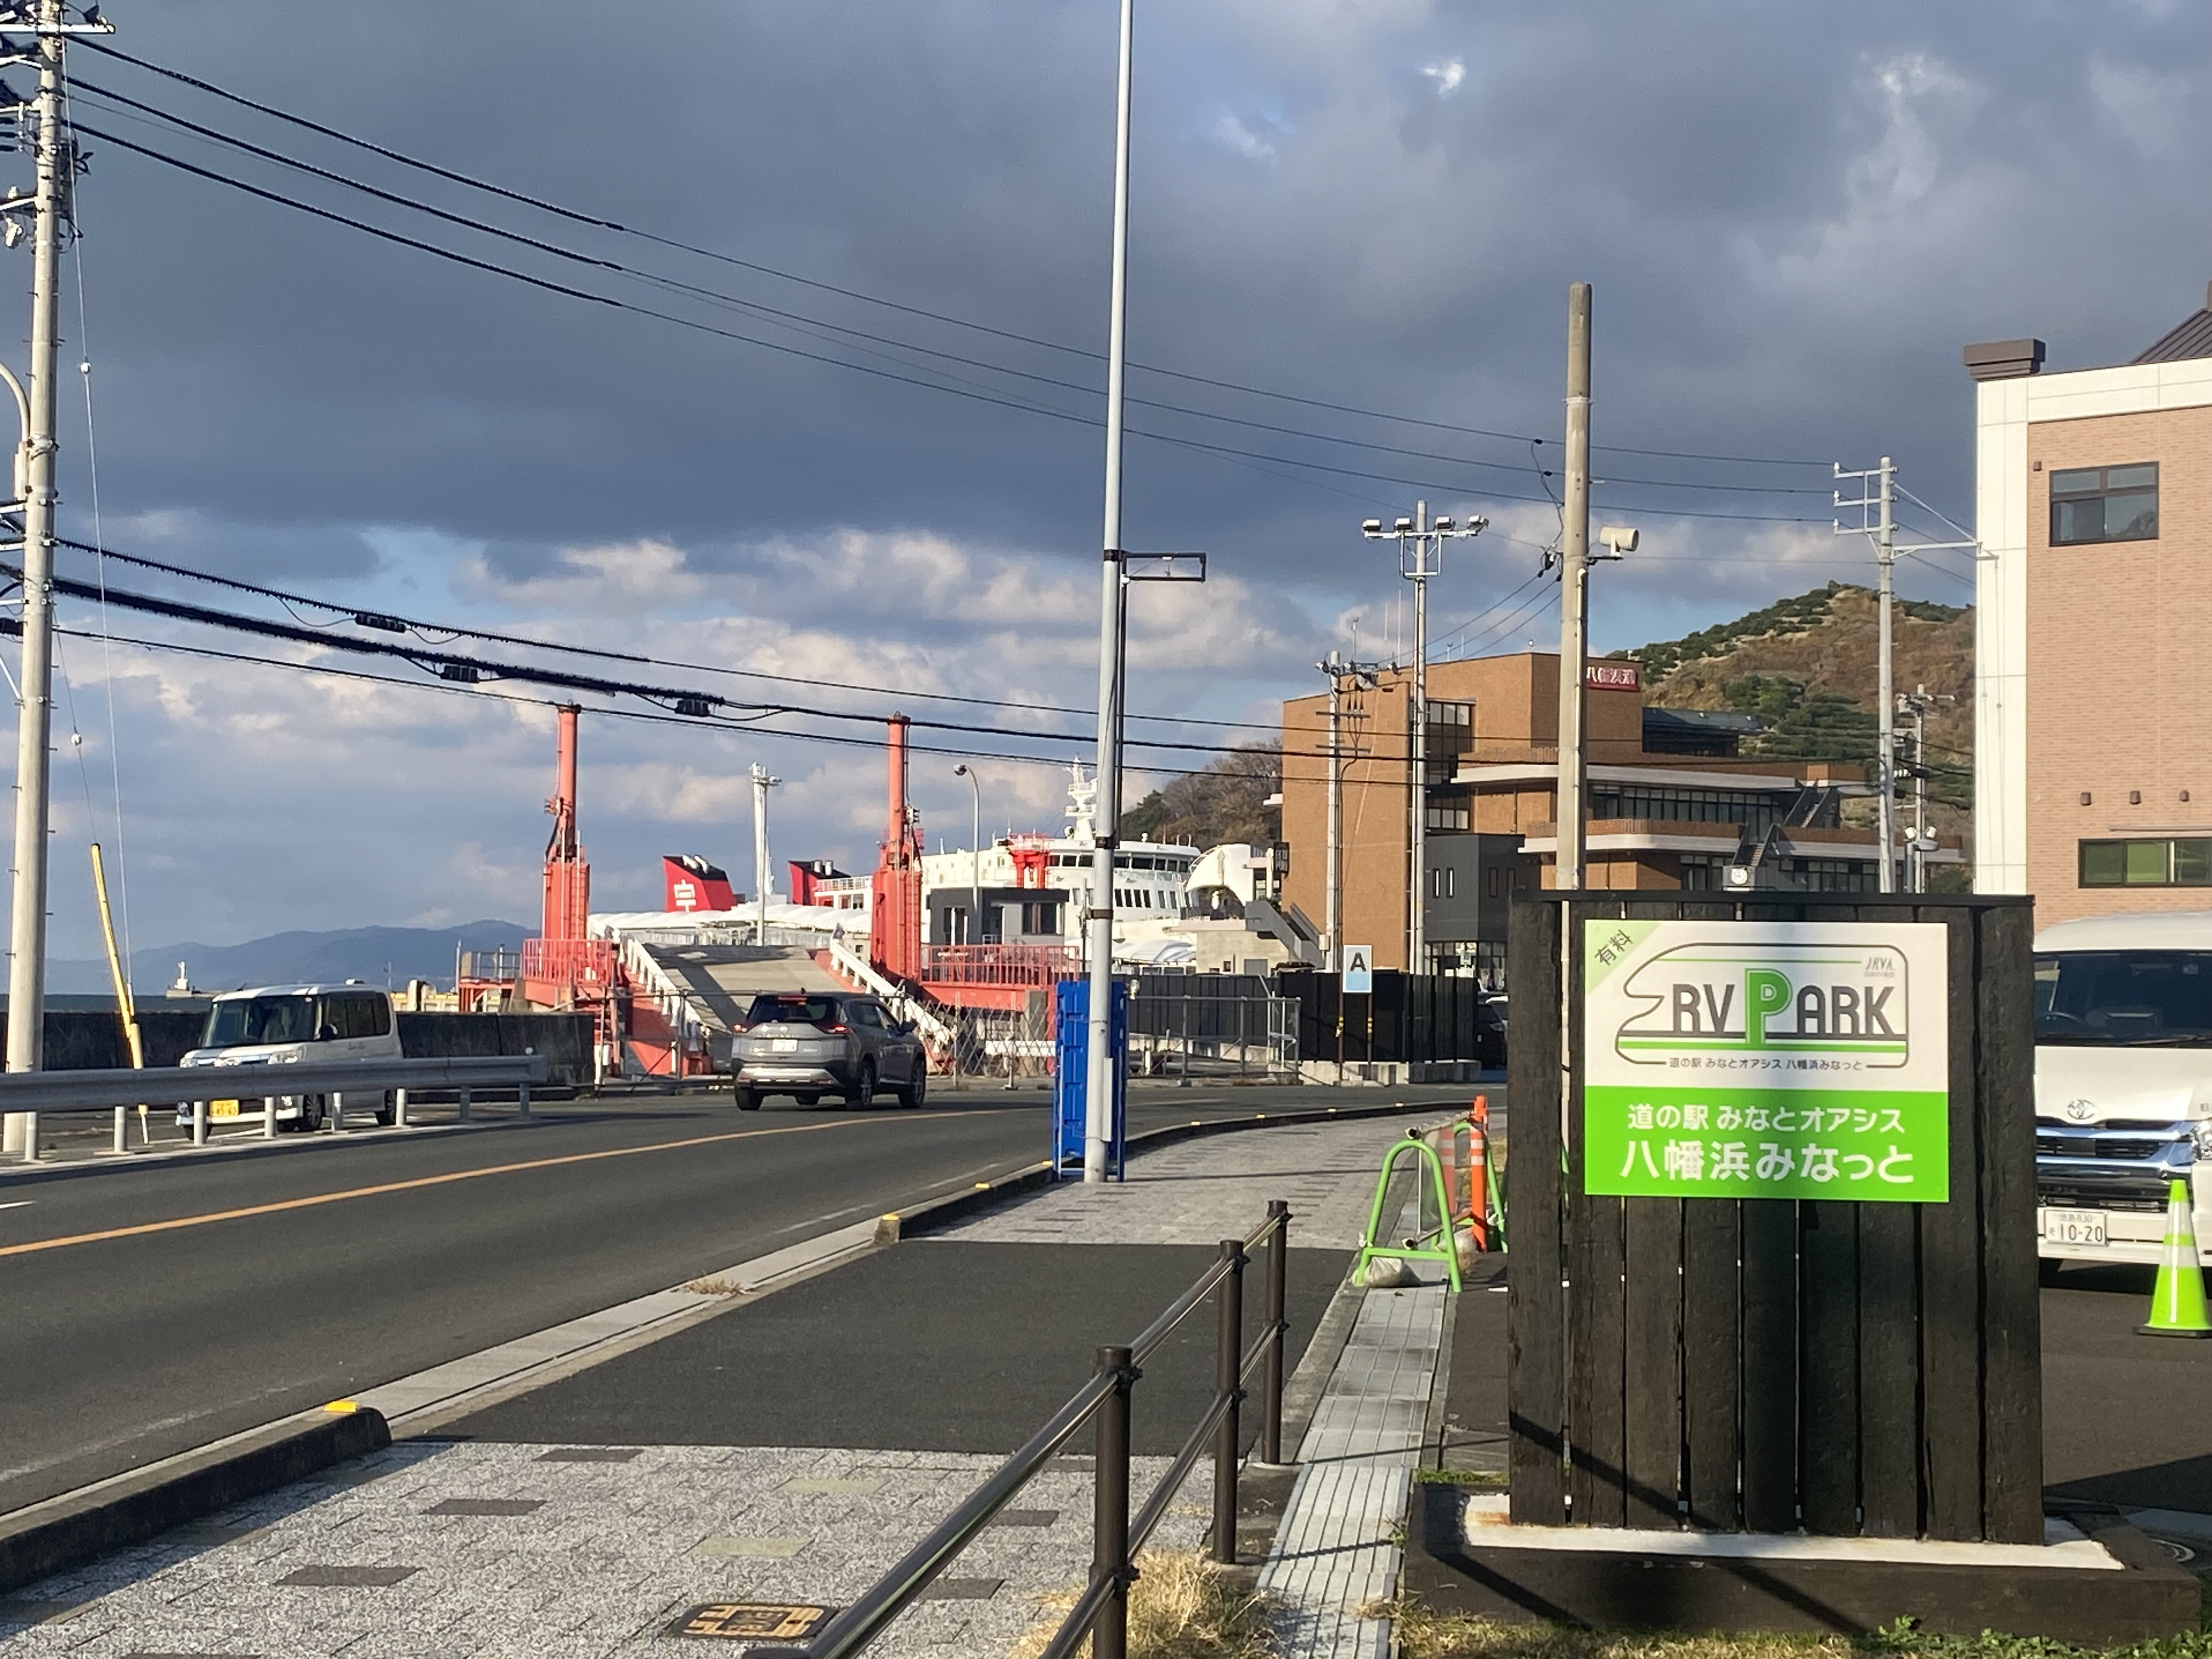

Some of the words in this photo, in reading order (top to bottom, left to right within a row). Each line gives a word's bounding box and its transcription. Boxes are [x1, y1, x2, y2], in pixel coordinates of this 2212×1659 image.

[1350, 951, 1367, 972] A
[1594, 929, 1633, 966] 有料
[1673, 984, 1735, 1034] RV
[1745, 967, 1895, 1043] PARK
[1669, 1057, 1702, 1069] 道の駅
[1706, 1058, 1782, 1069] みなとオアシス
[1786, 1059, 1863, 1070] 八幡浜みなっと
[1628, 1103, 1709, 1131] 道の駅
[1717, 1105, 1905, 1133] みなとオアシス
[1620, 1139, 1914, 1183] 八幡浜みなっと
[2061, 1223, 2103, 1242] 10-20
